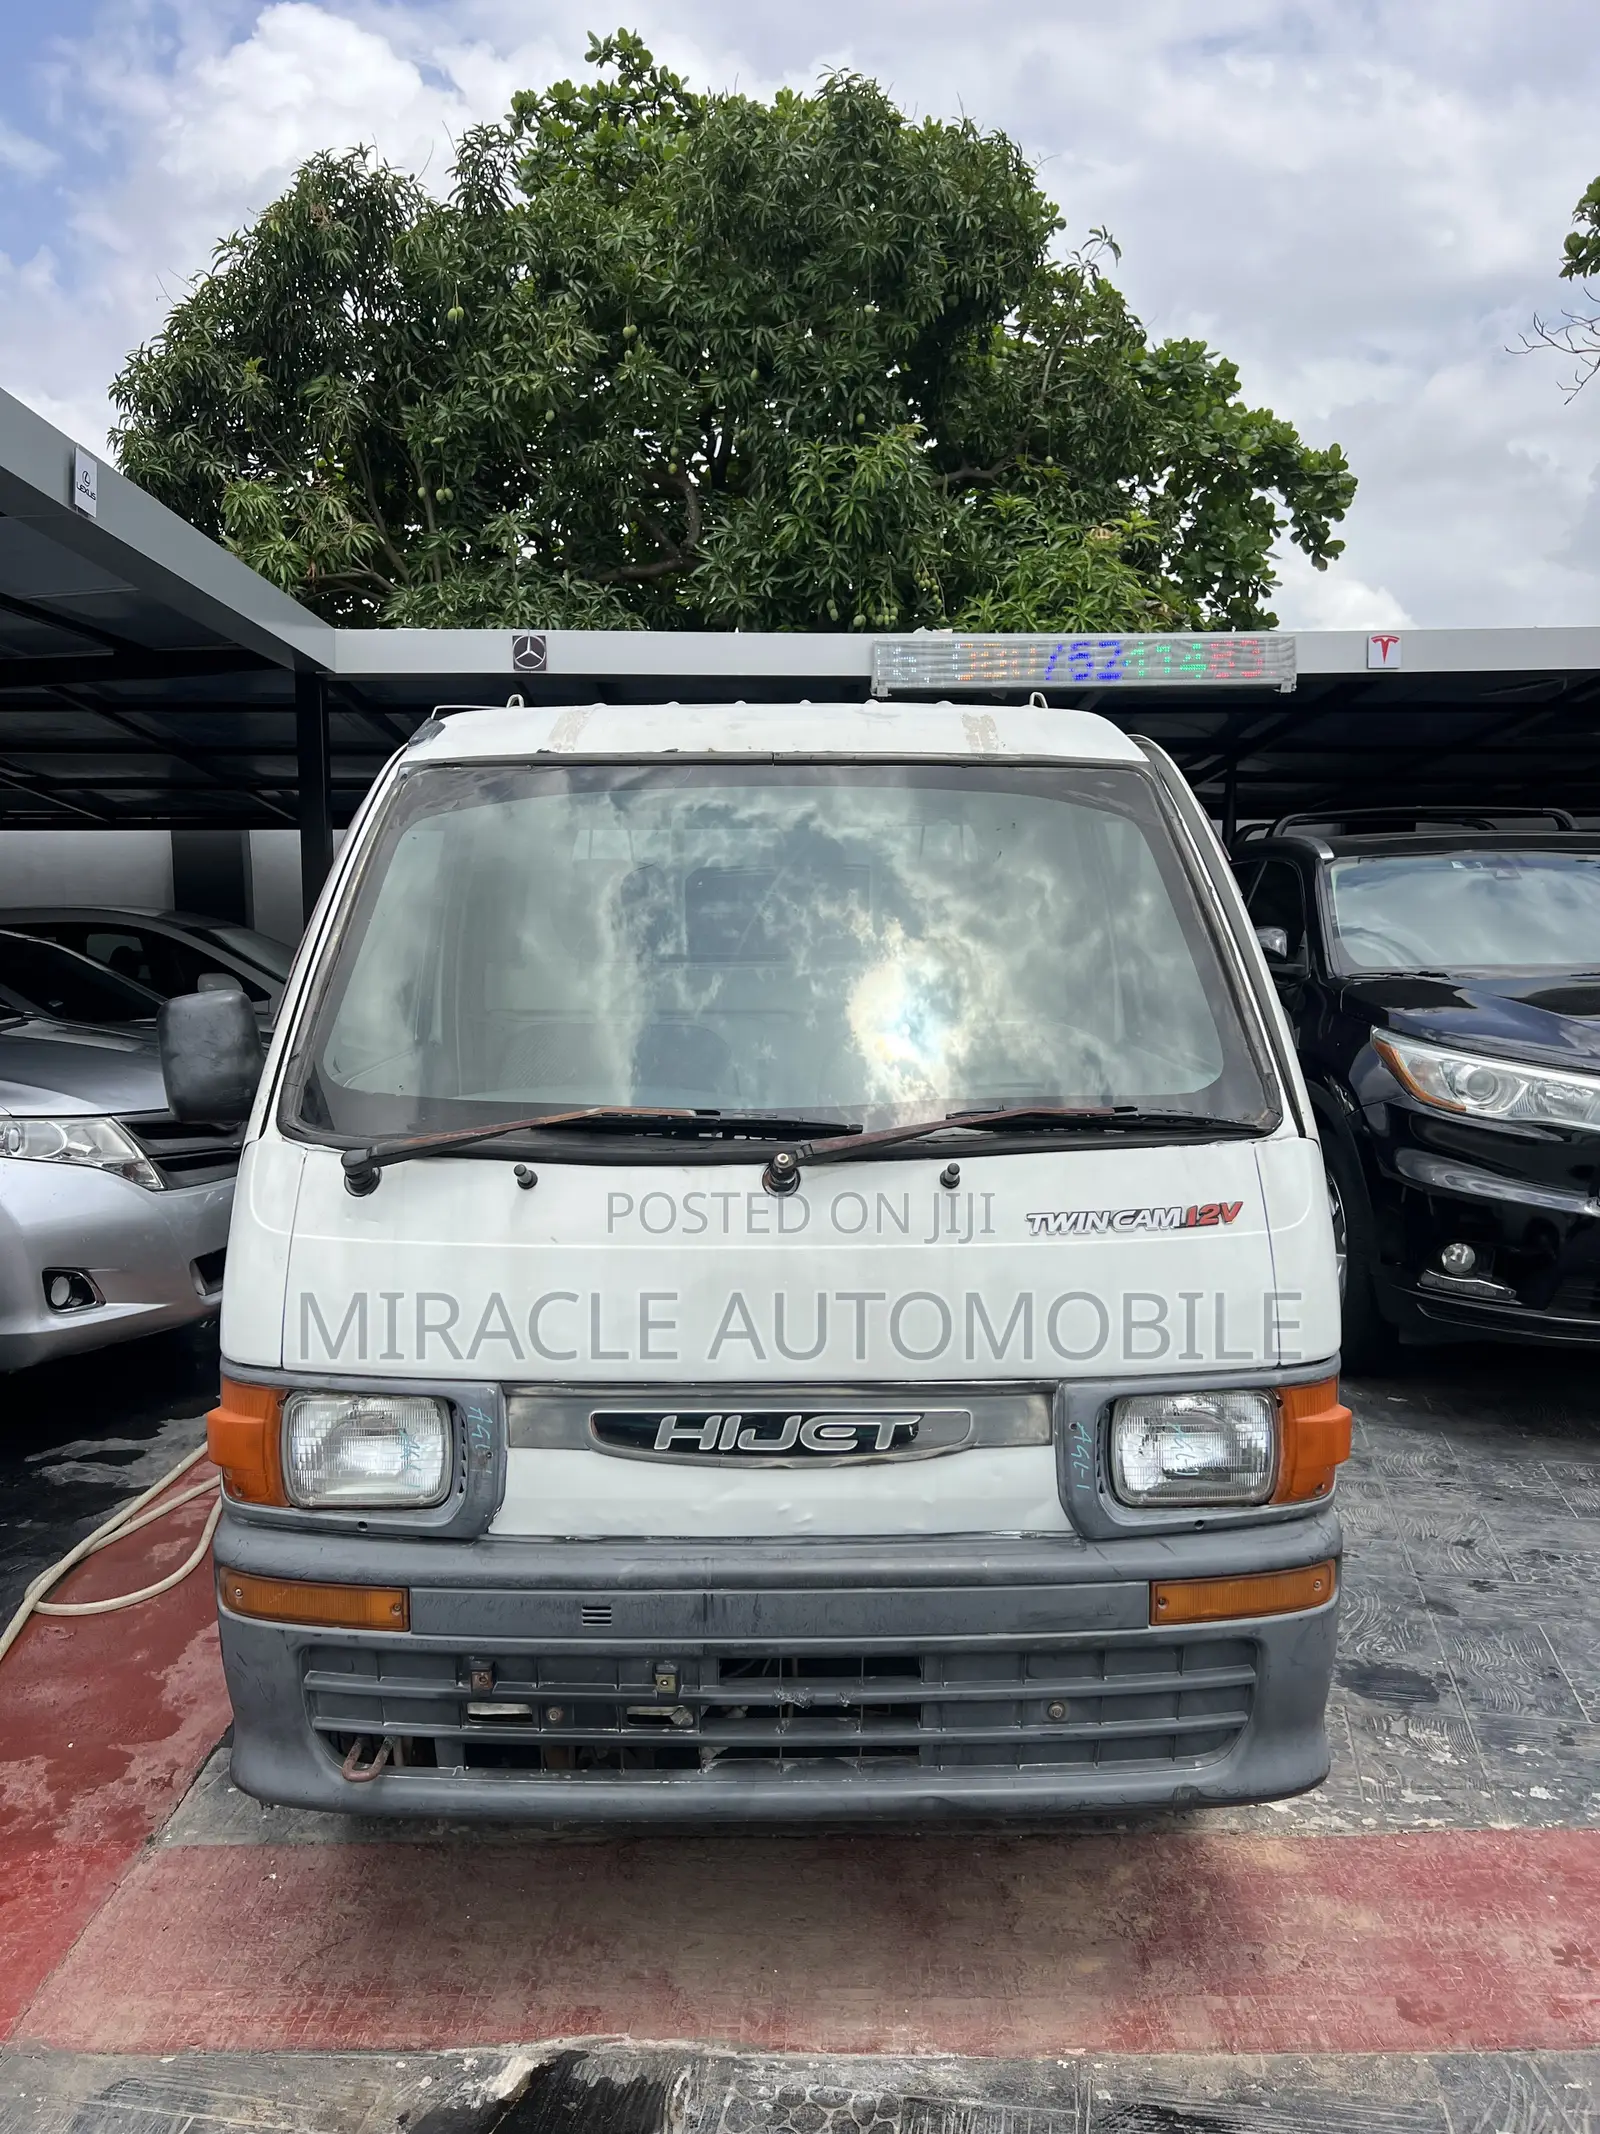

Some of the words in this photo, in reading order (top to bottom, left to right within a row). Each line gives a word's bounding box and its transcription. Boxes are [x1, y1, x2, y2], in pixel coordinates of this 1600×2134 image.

[76, 481, 96, 500] LEXUS
[1185, 1201, 1244, 1229] 12V
[653, 1414, 922, 1451] HIJET
